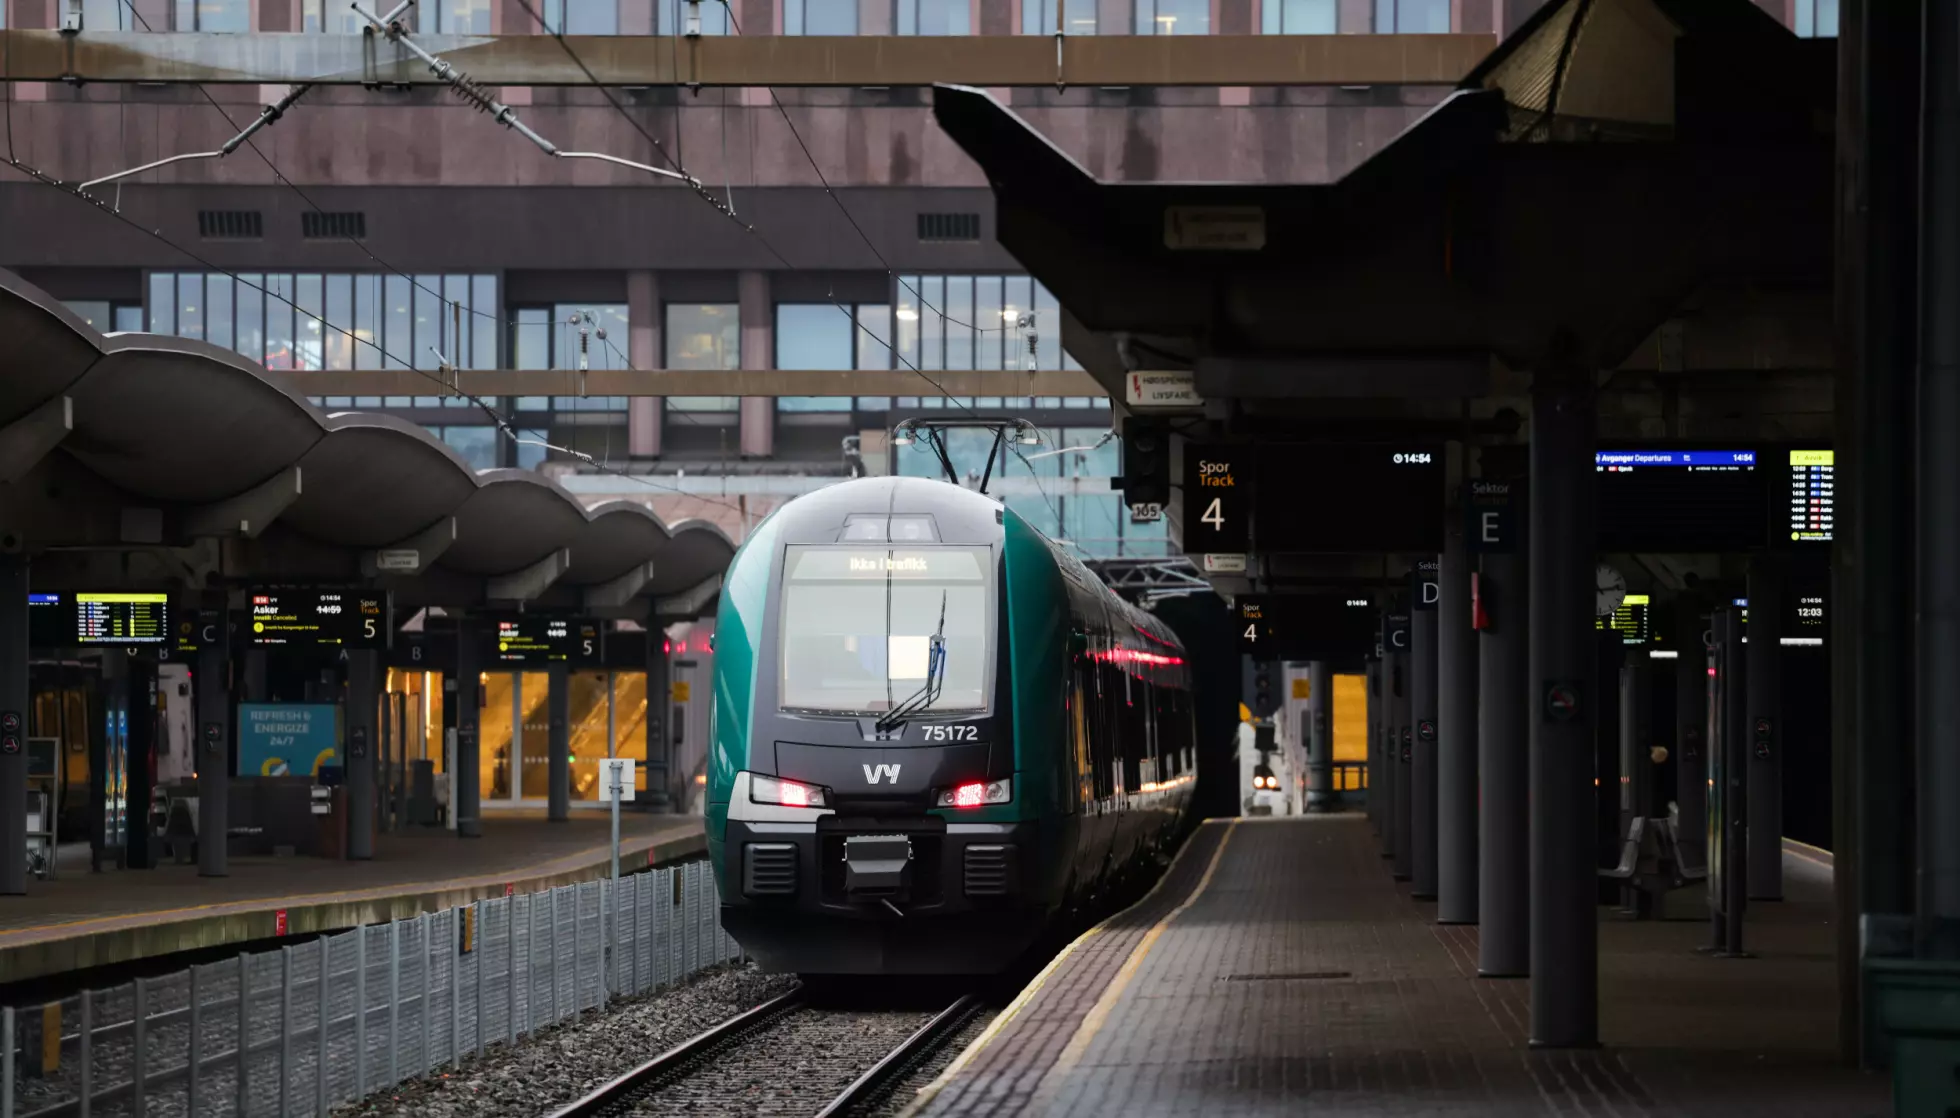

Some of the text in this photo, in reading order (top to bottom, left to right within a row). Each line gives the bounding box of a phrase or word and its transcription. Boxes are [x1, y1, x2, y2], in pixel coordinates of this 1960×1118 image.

[1403, 453, 1431, 463] 14:54
[1199, 460, 1230, 475] Spor
[1199, 474, 1235, 487] Track
[1472, 481, 1509, 493] Sektor
[1135, 505, 1158, 517] 105
[1201, 497, 1226, 531] 4
[1482, 512, 1500, 543] E
[1422, 582, 1439, 604] D
[253, 605, 279, 614] Asker
[360, 600, 377, 609] Spor
[360, 606, 380, 614] Track
[1243, 603, 1260, 612] Spor
[1243, 610, 1263, 618] Track
[1797, 607, 1823, 617] 12:03
[202, 624, 216, 643] C
[364, 618, 377, 640] 5
[1243, 623, 1257, 642] 4
[1391, 629, 1406, 648] C
[412, 646, 422, 661] B
[582, 639, 593, 656] 5
[250, 711, 299, 721] REFRESH
[254, 723, 310, 733] ENERGIZE
[922, 726, 978, 741] 75172
[269, 736, 295, 746] 24/7
